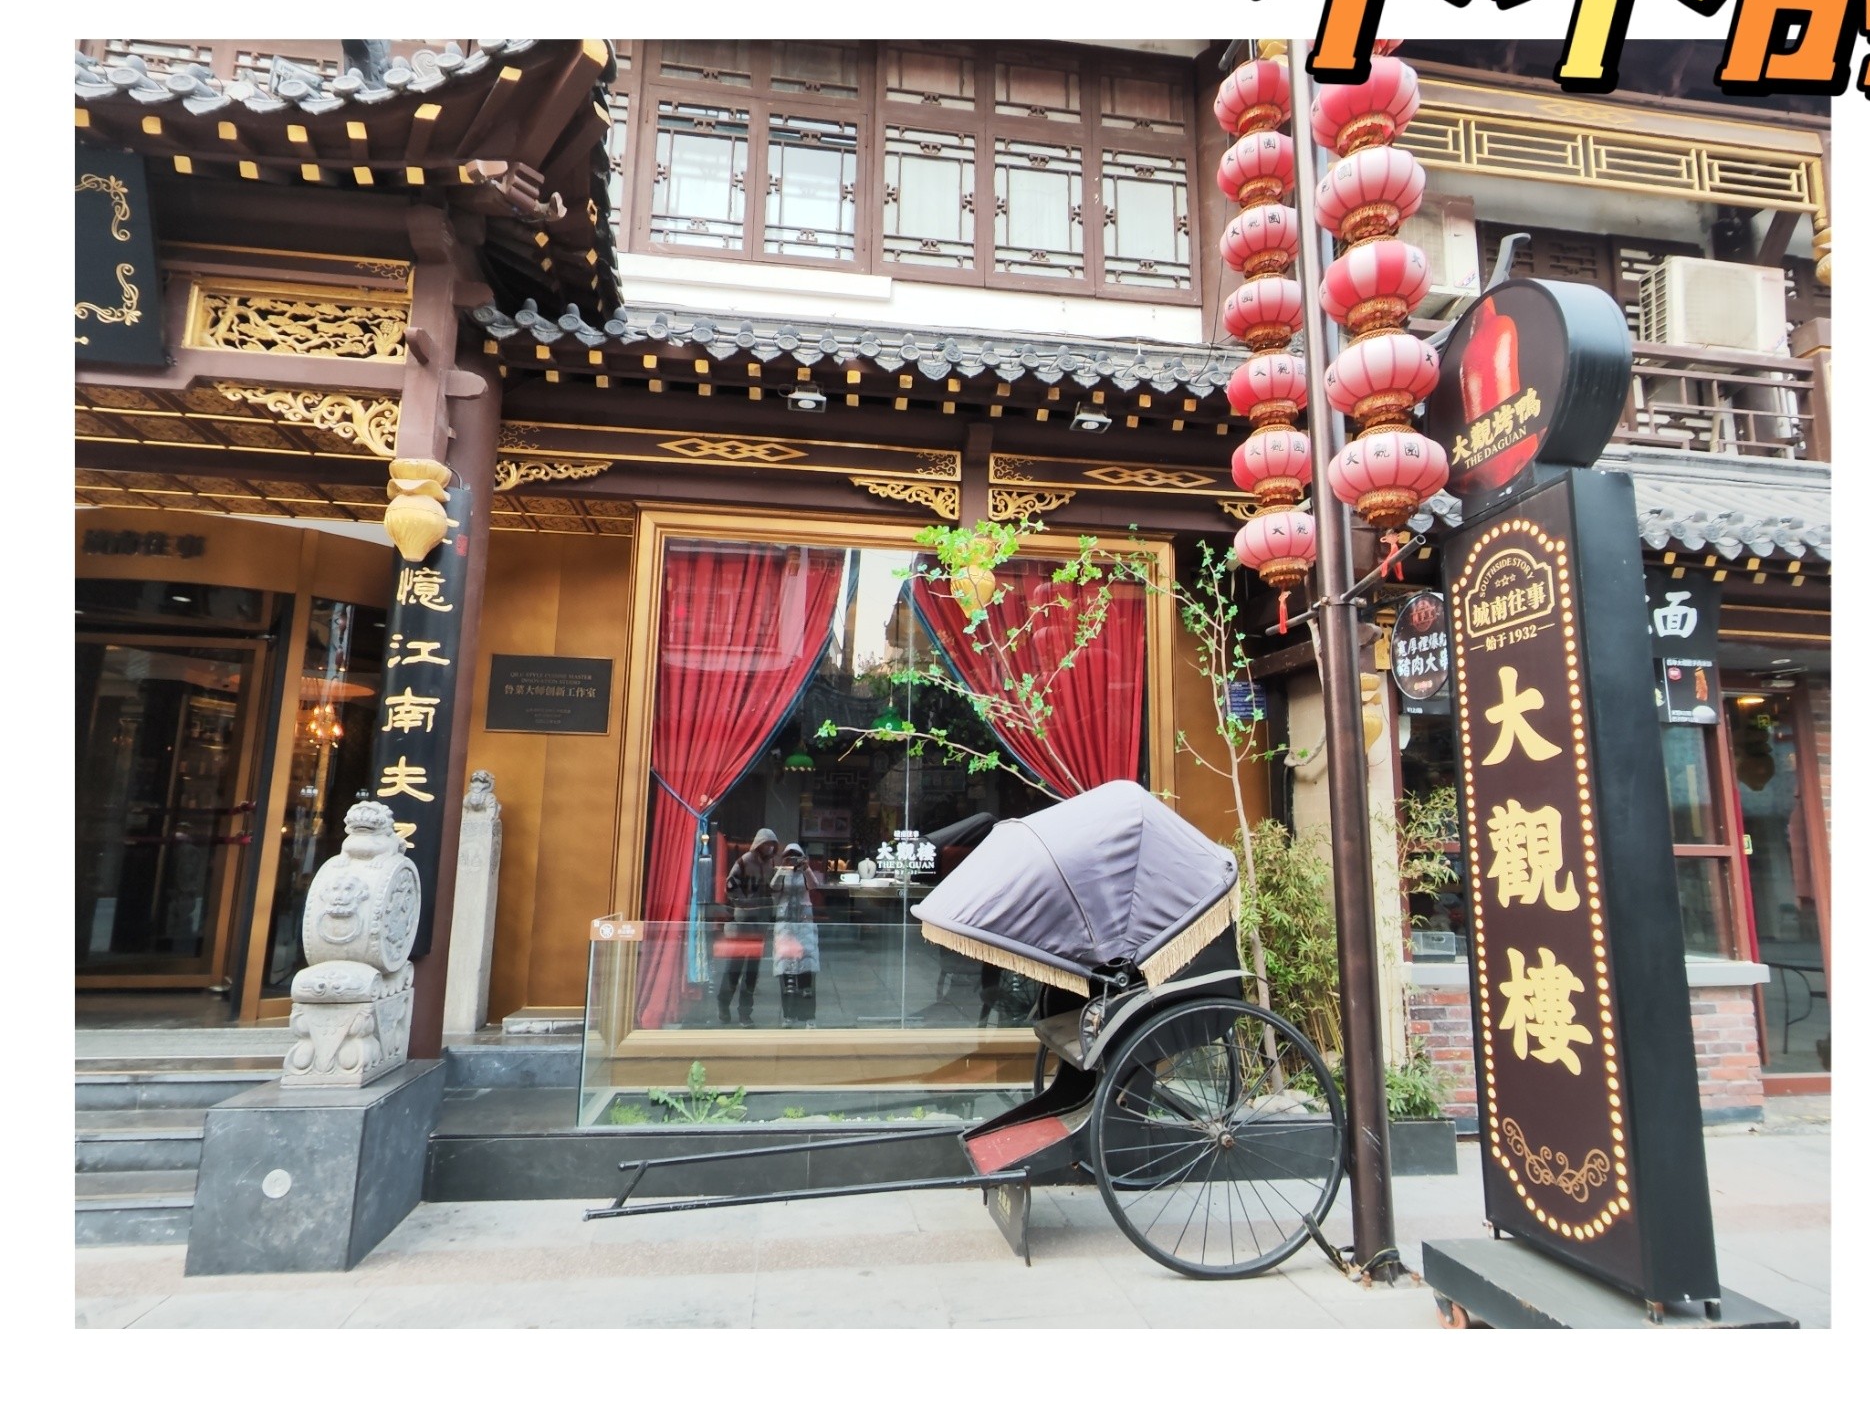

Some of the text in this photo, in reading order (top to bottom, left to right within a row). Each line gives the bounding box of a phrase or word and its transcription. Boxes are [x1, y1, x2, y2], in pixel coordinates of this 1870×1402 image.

[1464, 425, 1527, 470] THE DAGUAN
[1472, 580, 1547, 628] 城南往事
[1485, 625, 1538, 652] 始于1932
[877, 860, 935, 869] THE DGUAN
[1482, 665, 1593, 1076] 大觀樓
